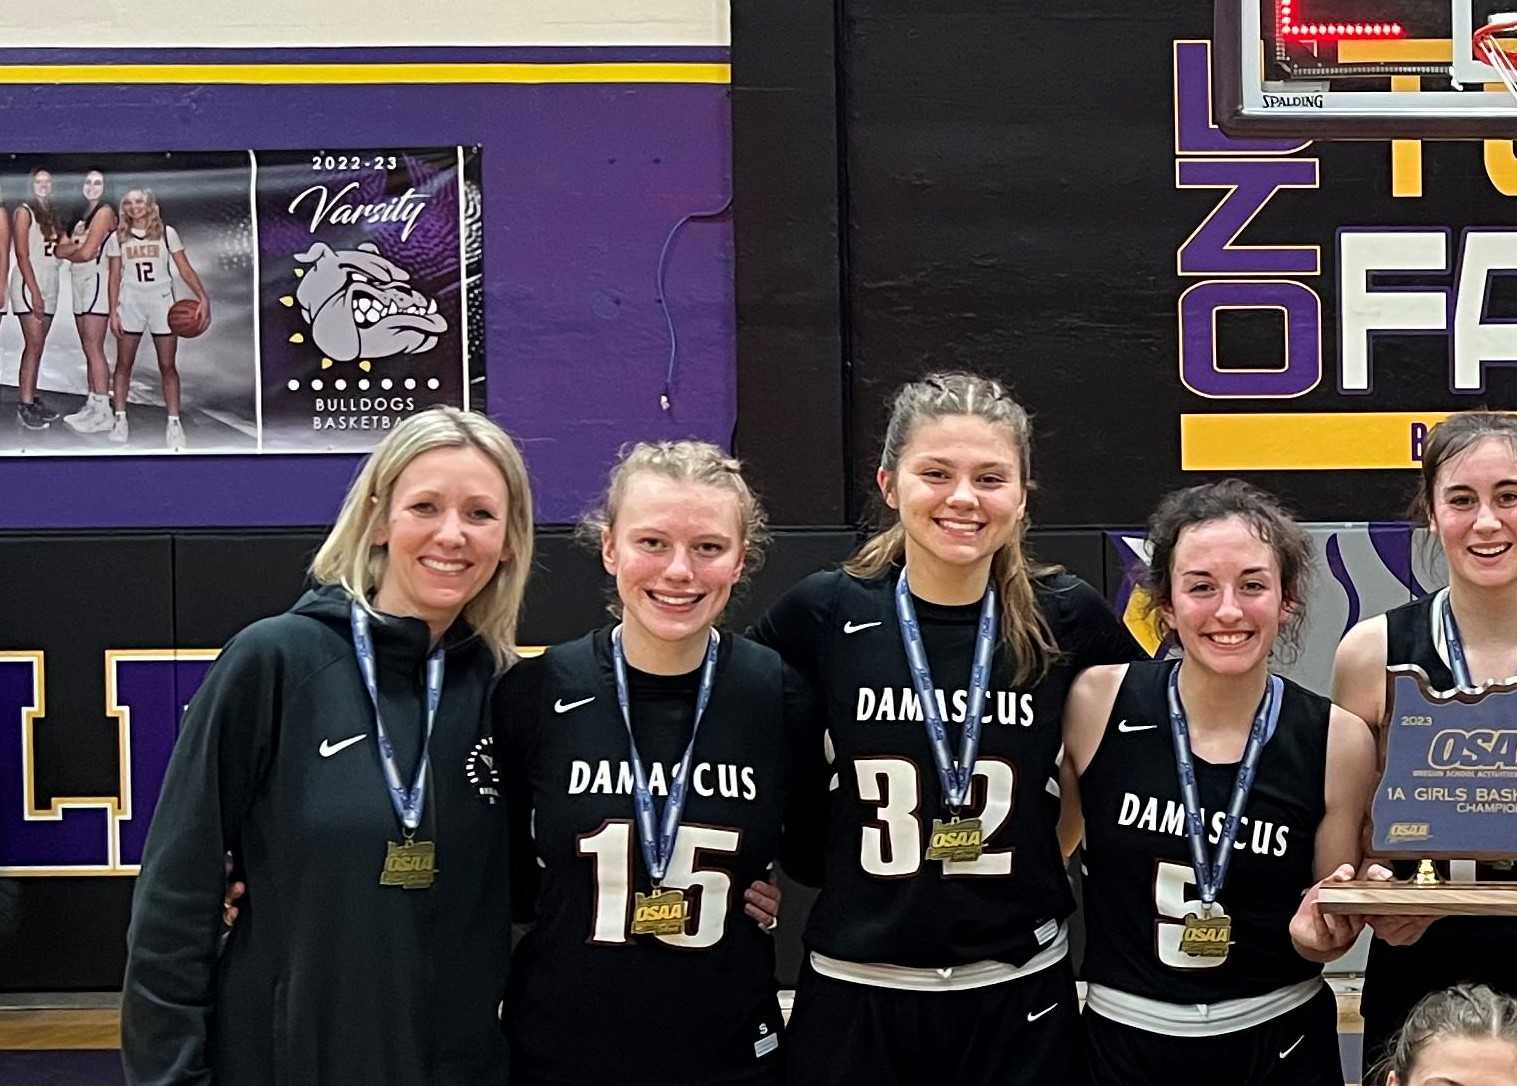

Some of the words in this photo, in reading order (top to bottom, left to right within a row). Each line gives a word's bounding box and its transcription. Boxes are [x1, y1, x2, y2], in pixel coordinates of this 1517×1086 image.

[1262, 94, 1323, 108] SPALDING
[312, 156, 397, 170] 2022-23
[288, 182, 432, 242] Varsity
[136, 262, 155, 282] 12
[315, 397, 415, 412] BULLDOGS
[312, 416, 401, 430] BASKETB
[1399, 716, 1433, 727] 2023
[567, 759, 758, 801] DAMACUS
[1387, 787, 1406, 800] 1A
[1414, 787, 1467, 801] GIRLS
[853, 758, 1014, 876] 32
[1117, 792, 1290, 857] DAMSUS
[932, 831, 979, 848] OSAA
[577, 820, 742, 948] 15
[637, 904, 682, 921] OSAA
[1183, 928, 1228, 943] OSAA
[759, 1023, 769, 1035] S
